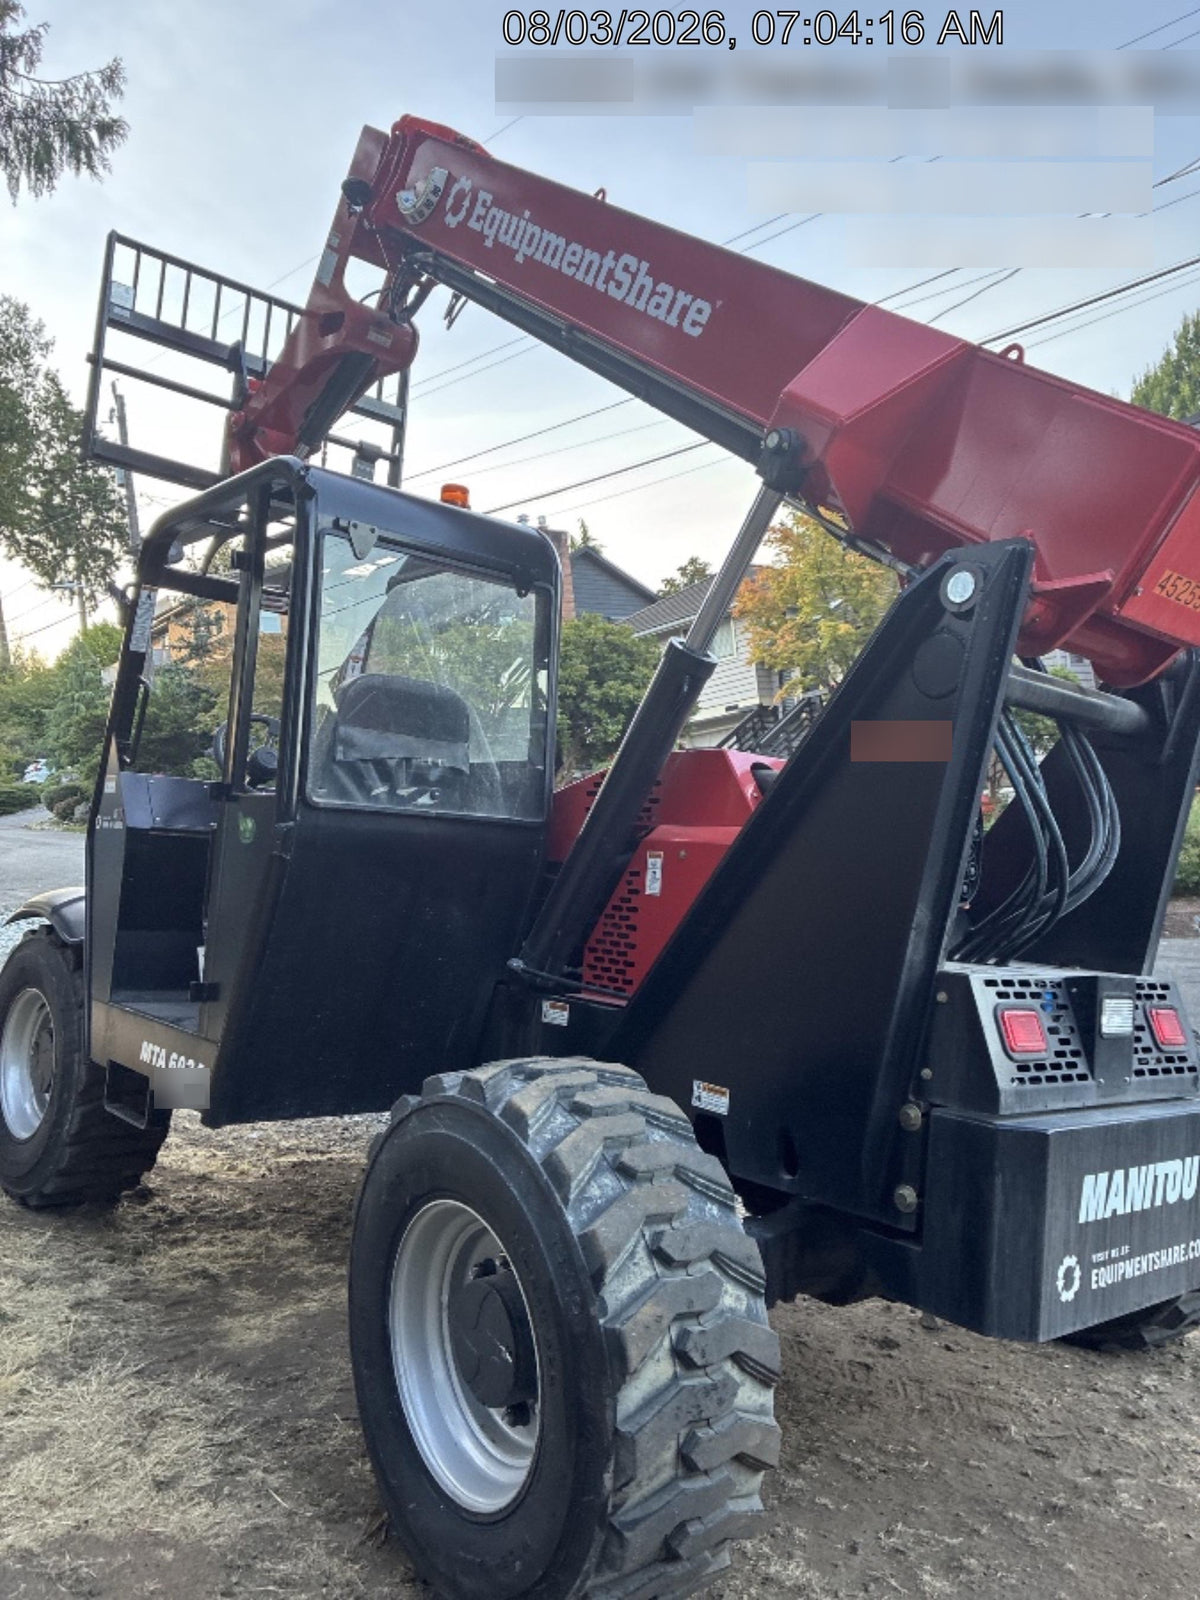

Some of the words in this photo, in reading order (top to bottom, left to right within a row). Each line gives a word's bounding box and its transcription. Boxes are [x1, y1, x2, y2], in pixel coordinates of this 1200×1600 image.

[467, 189, 714, 338] EquipmentShare
[140, 1040, 167, 1069] MTA
[1078, 1154, 1200, 1224] MANITOU
